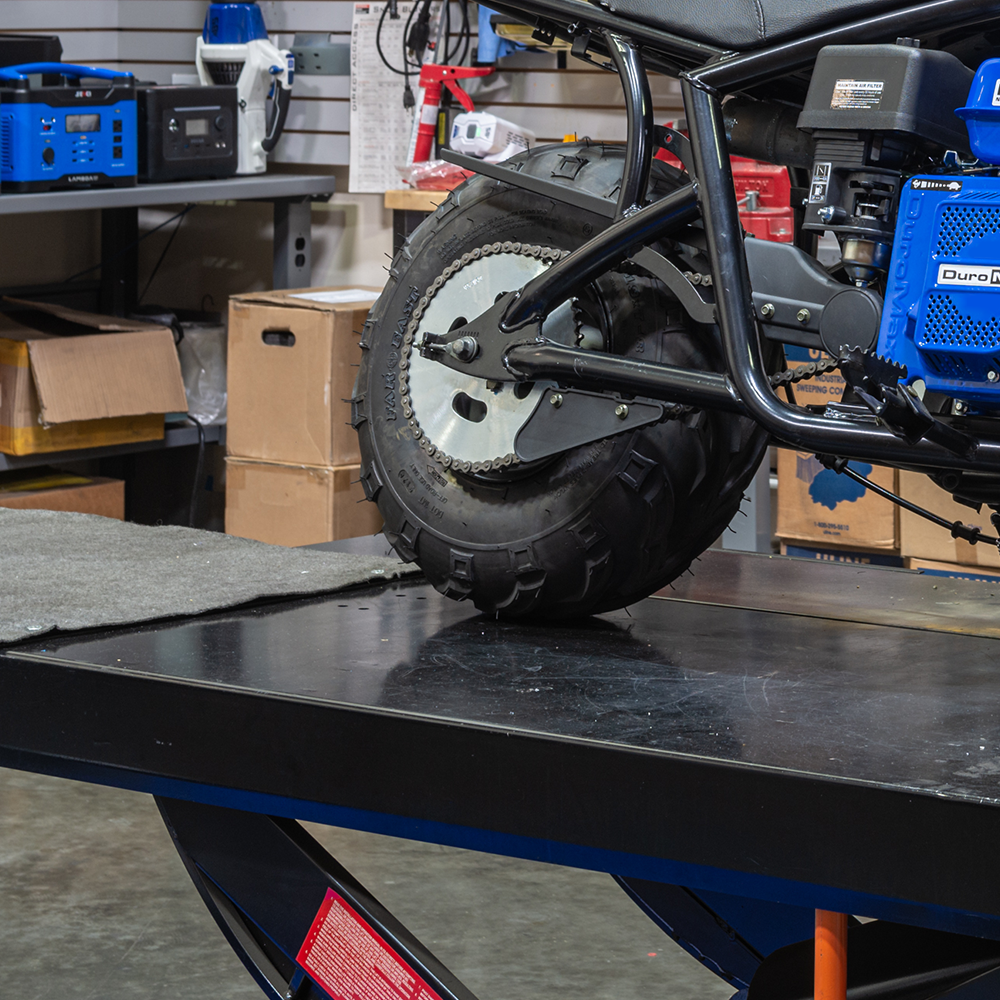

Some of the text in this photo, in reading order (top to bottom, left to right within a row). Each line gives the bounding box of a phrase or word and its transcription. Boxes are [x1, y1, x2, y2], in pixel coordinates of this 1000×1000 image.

[391, 284, 420, 348] EAST
[381, 372, 396, 422] FAR
[796, 385, 828, 394] SWEEPING
